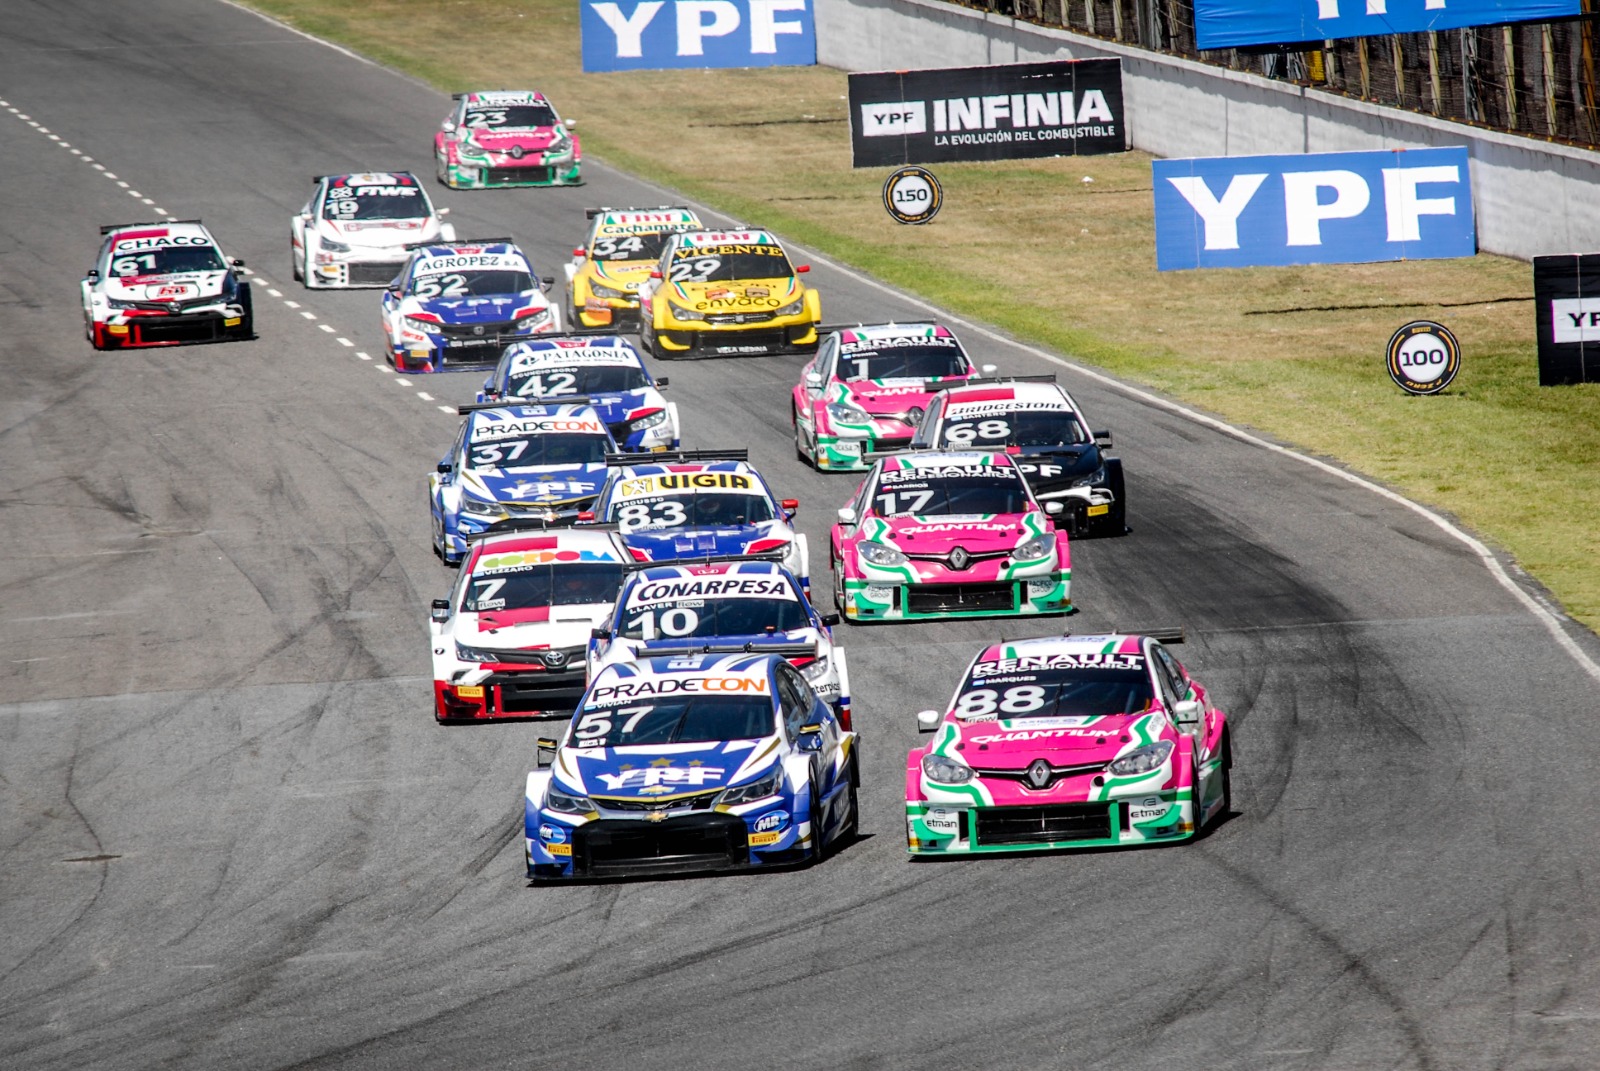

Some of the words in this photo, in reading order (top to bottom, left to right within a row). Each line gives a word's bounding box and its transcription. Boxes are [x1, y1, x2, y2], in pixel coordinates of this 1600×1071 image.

[589, 1, 806, 58] YPF
[873, 111, 915, 125] YPF
[933, 89, 1114, 132] INFINIA
[466, 111, 508, 128] 23
[934, 136, 949, 146] LA
[951, 130, 1012, 145] EVOLUCIÓN
[1015, 131, 1035, 142] DEL
[1037, 125, 1115, 141] COMBUSTIBLE
[896, 188, 928, 203] 150
[325, 200, 359, 215] 19
[1165, 165, 1460, 251] YPF
[603, 223, 698, 234] Cachamate
[118, 236, 209, 251] CHACO
[593, 236, 644, 256] 34
[675, 244, 784, 259] VICENTE
[112, 254, 157, 271] 61
[421, 256, 499, 271] AGROPEZ
[669, 259, 721, 282] 29
[414, 274, 469, 297] 52
[695, 298, 781, 310] envaco
[1567, 311, 1600, 328] YP
[841, 336, 955, 352] RENAULT
[543, 349, 630, 361] PATAGONIA
[1402, 348, 1444, 367] 100
[851, 358, 869, 381] 1
[516, 372, 578, 397] 42
[861, 386, 926, 397] QUANT
[952, 400, 1066, 416] BRIDGESTONE
[962, 411, 1007, 420] SANTERO
[476, 420, 598, 437] PRADECON
[944, 419, 1012, 442] 68
[471, 440, 529, 464] 37
[880, 463, 1017, 481] RENAULT
[1019, 464, 1063, 477] PF
[499, 482, 596, 499] YPF
[615, 497, 665, 509] ARDUSSO
[877, 489, 935, 516] 17
[618, 501, 688, 530] 83
[898, 523, 1016, 535] QUANTIUM
[484, 565, 534, 575] VEZZARO
[474, 578, 507, 602] 7
[638, 580, 786, 601] CONARPESA
[480, 600, 504, 609] flow
[629, 601, 673, 614] LLAVER
[627, 608, 699, 640] 10
[972, 652, 1145, 675] RENAULT
[972, 660, 1143, 679] CONCESIONARIOS
[985, 675, 1037, 685] MARQUES
[592, 677, 766, 702] PRADECON
[596, 699, 632, 709] VIVIAN
[954, 685, 1046, 720] 88
[574, 705, 654, 739] 57
[970, 728, 1120, 744] QUANTIUM
[595, 766, 725, 791] YPF
